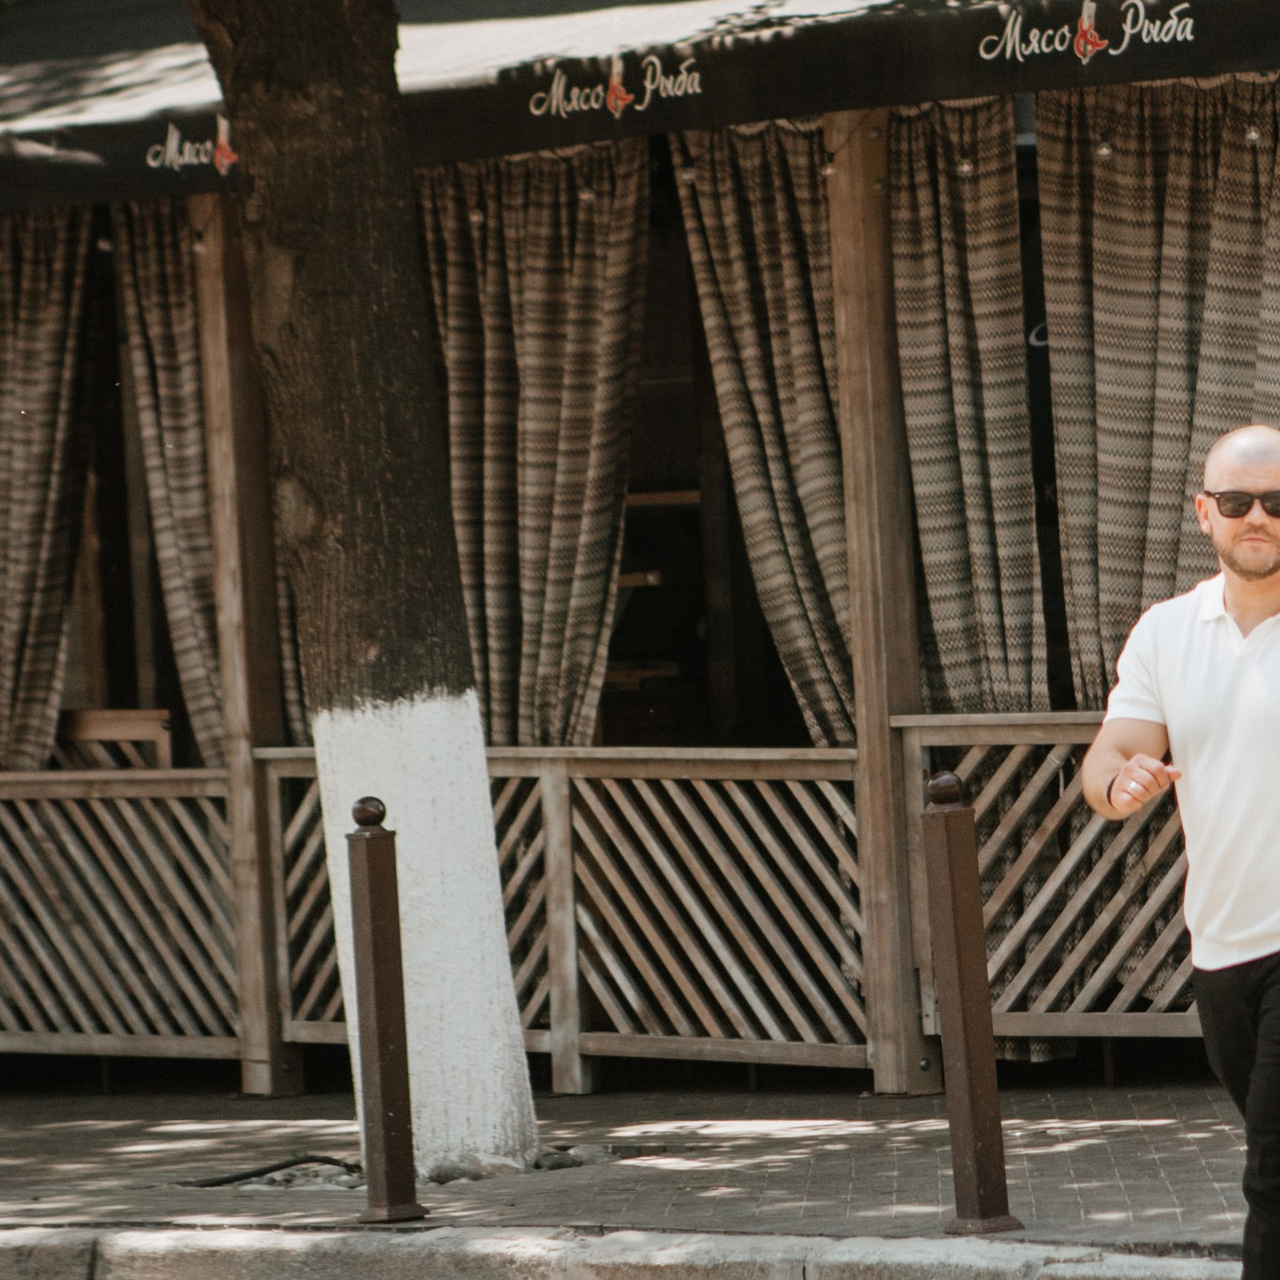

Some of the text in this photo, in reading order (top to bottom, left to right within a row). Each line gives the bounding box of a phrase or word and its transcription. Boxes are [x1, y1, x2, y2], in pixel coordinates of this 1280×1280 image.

[979, 10, 1072, 63] Мясо
[529, 68, 604, 118] Мясо
[634, 55, 702, 111] Рыба
[146, 121, 213, 172] Мясо
